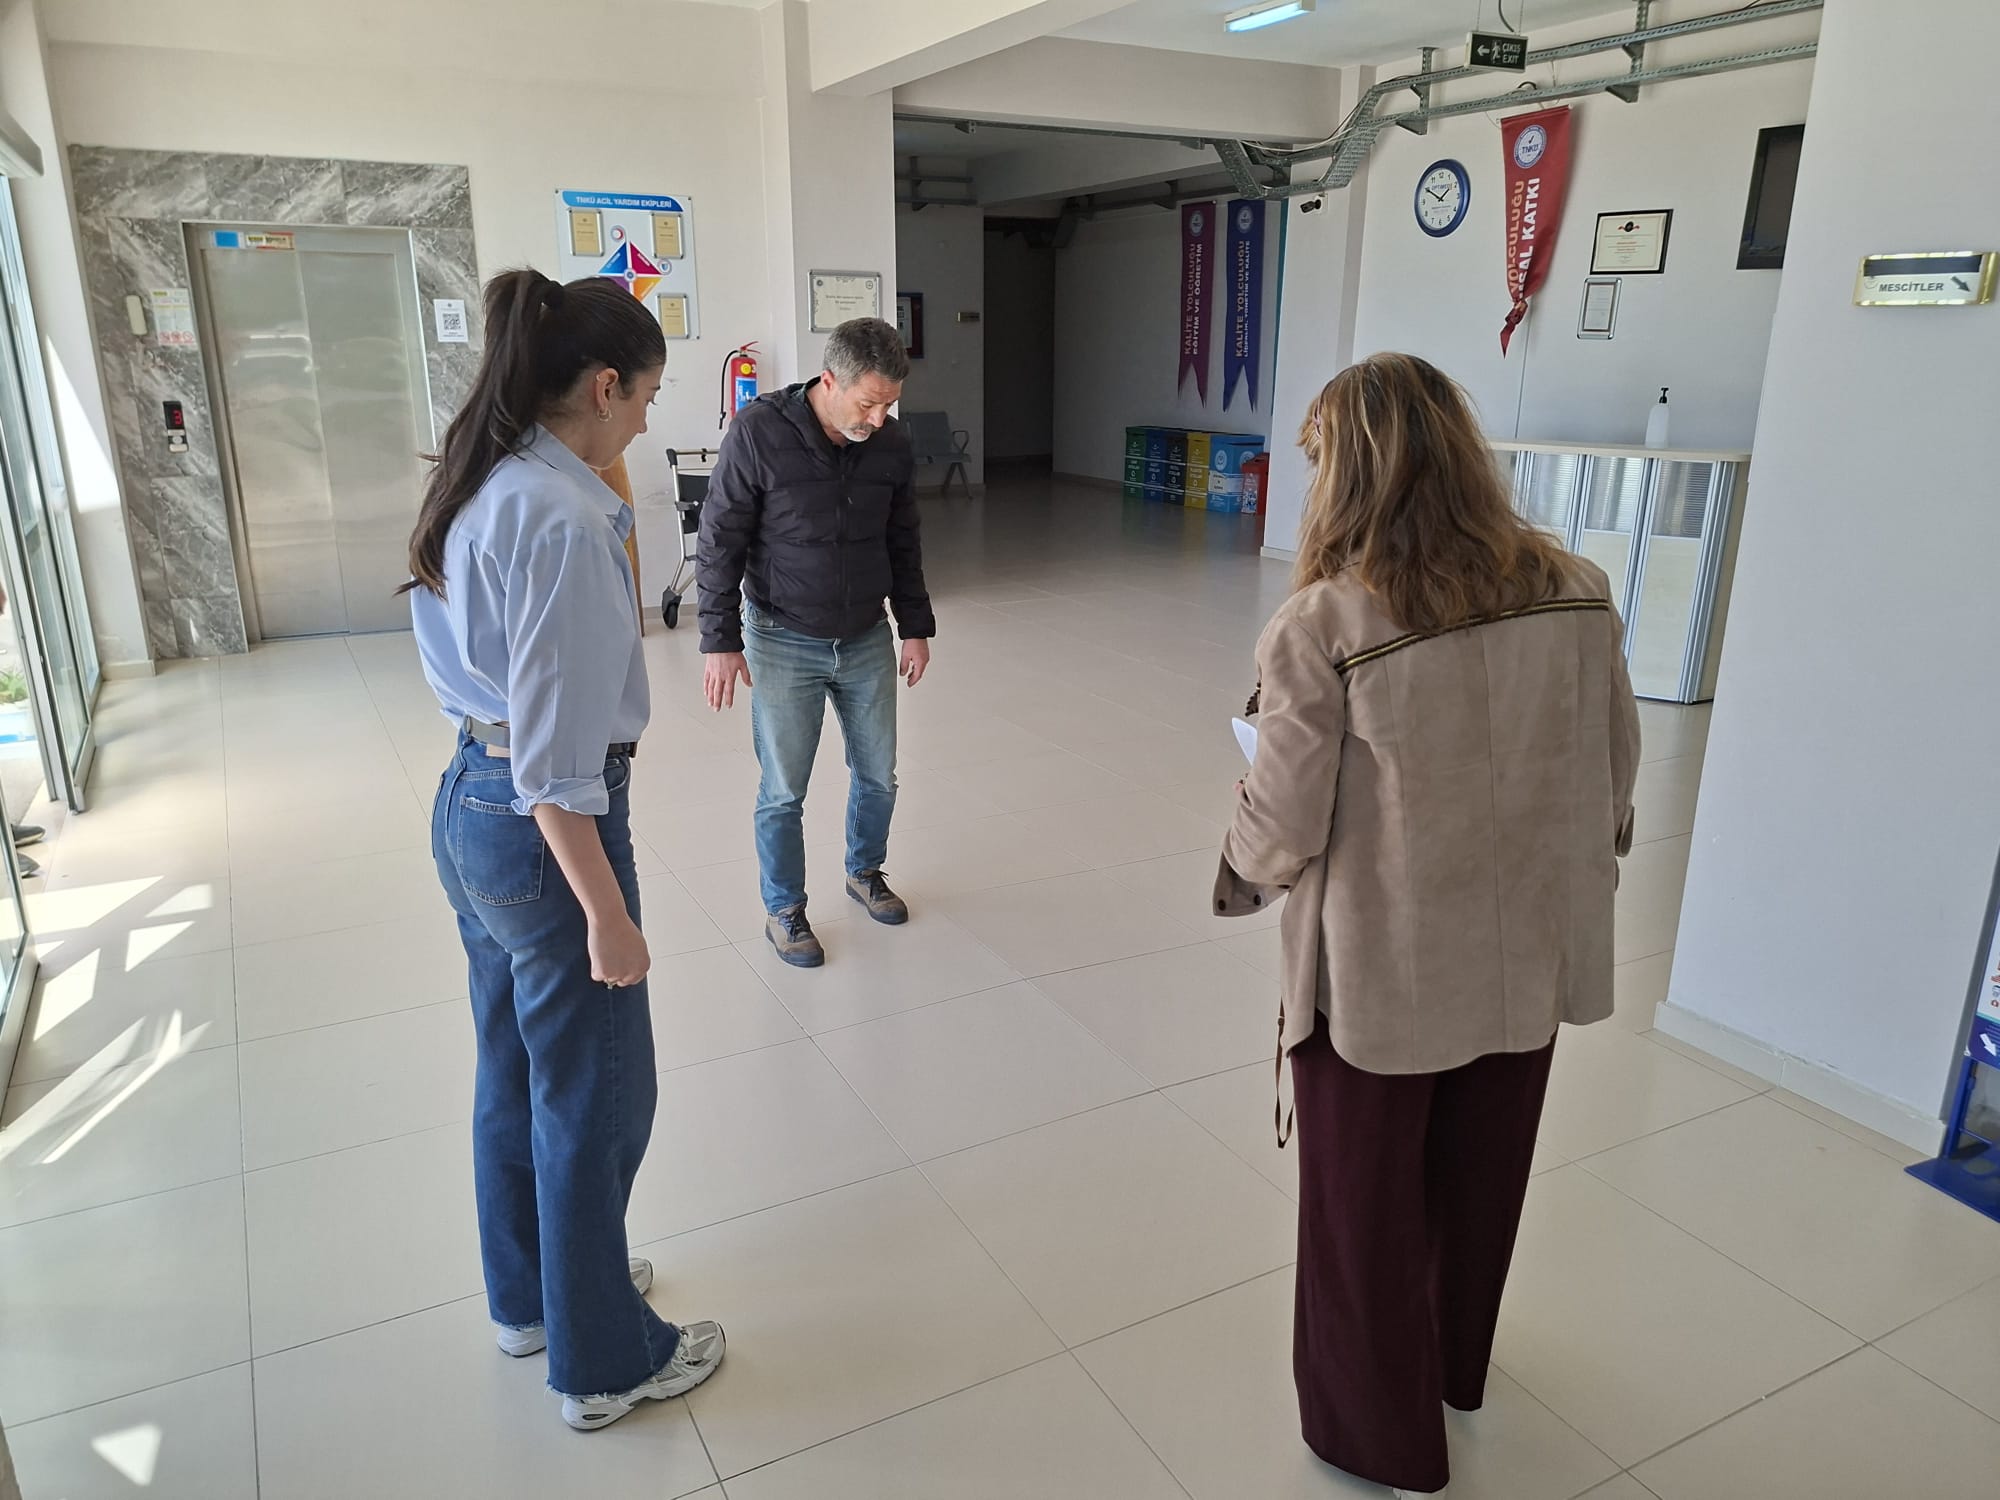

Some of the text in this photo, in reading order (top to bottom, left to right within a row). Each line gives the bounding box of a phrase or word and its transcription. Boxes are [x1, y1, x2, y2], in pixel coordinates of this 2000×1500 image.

[1503, 43, 1520, 54] ÇIKIŞ
[1503, 54, 1519, 64] EXIT
[1522, 178, 1540, 240] KATKI
[1879, 282, 1944, 292] MESCİTLER
[1185, 244, 1195, 354] KALİTE YOLCULUĞU
[1194, 299, 1200, 313] VE
[1236, 241, 1245, 357] KALİTE YOLCULUĞU
[174, 410, 182, 425] 3
